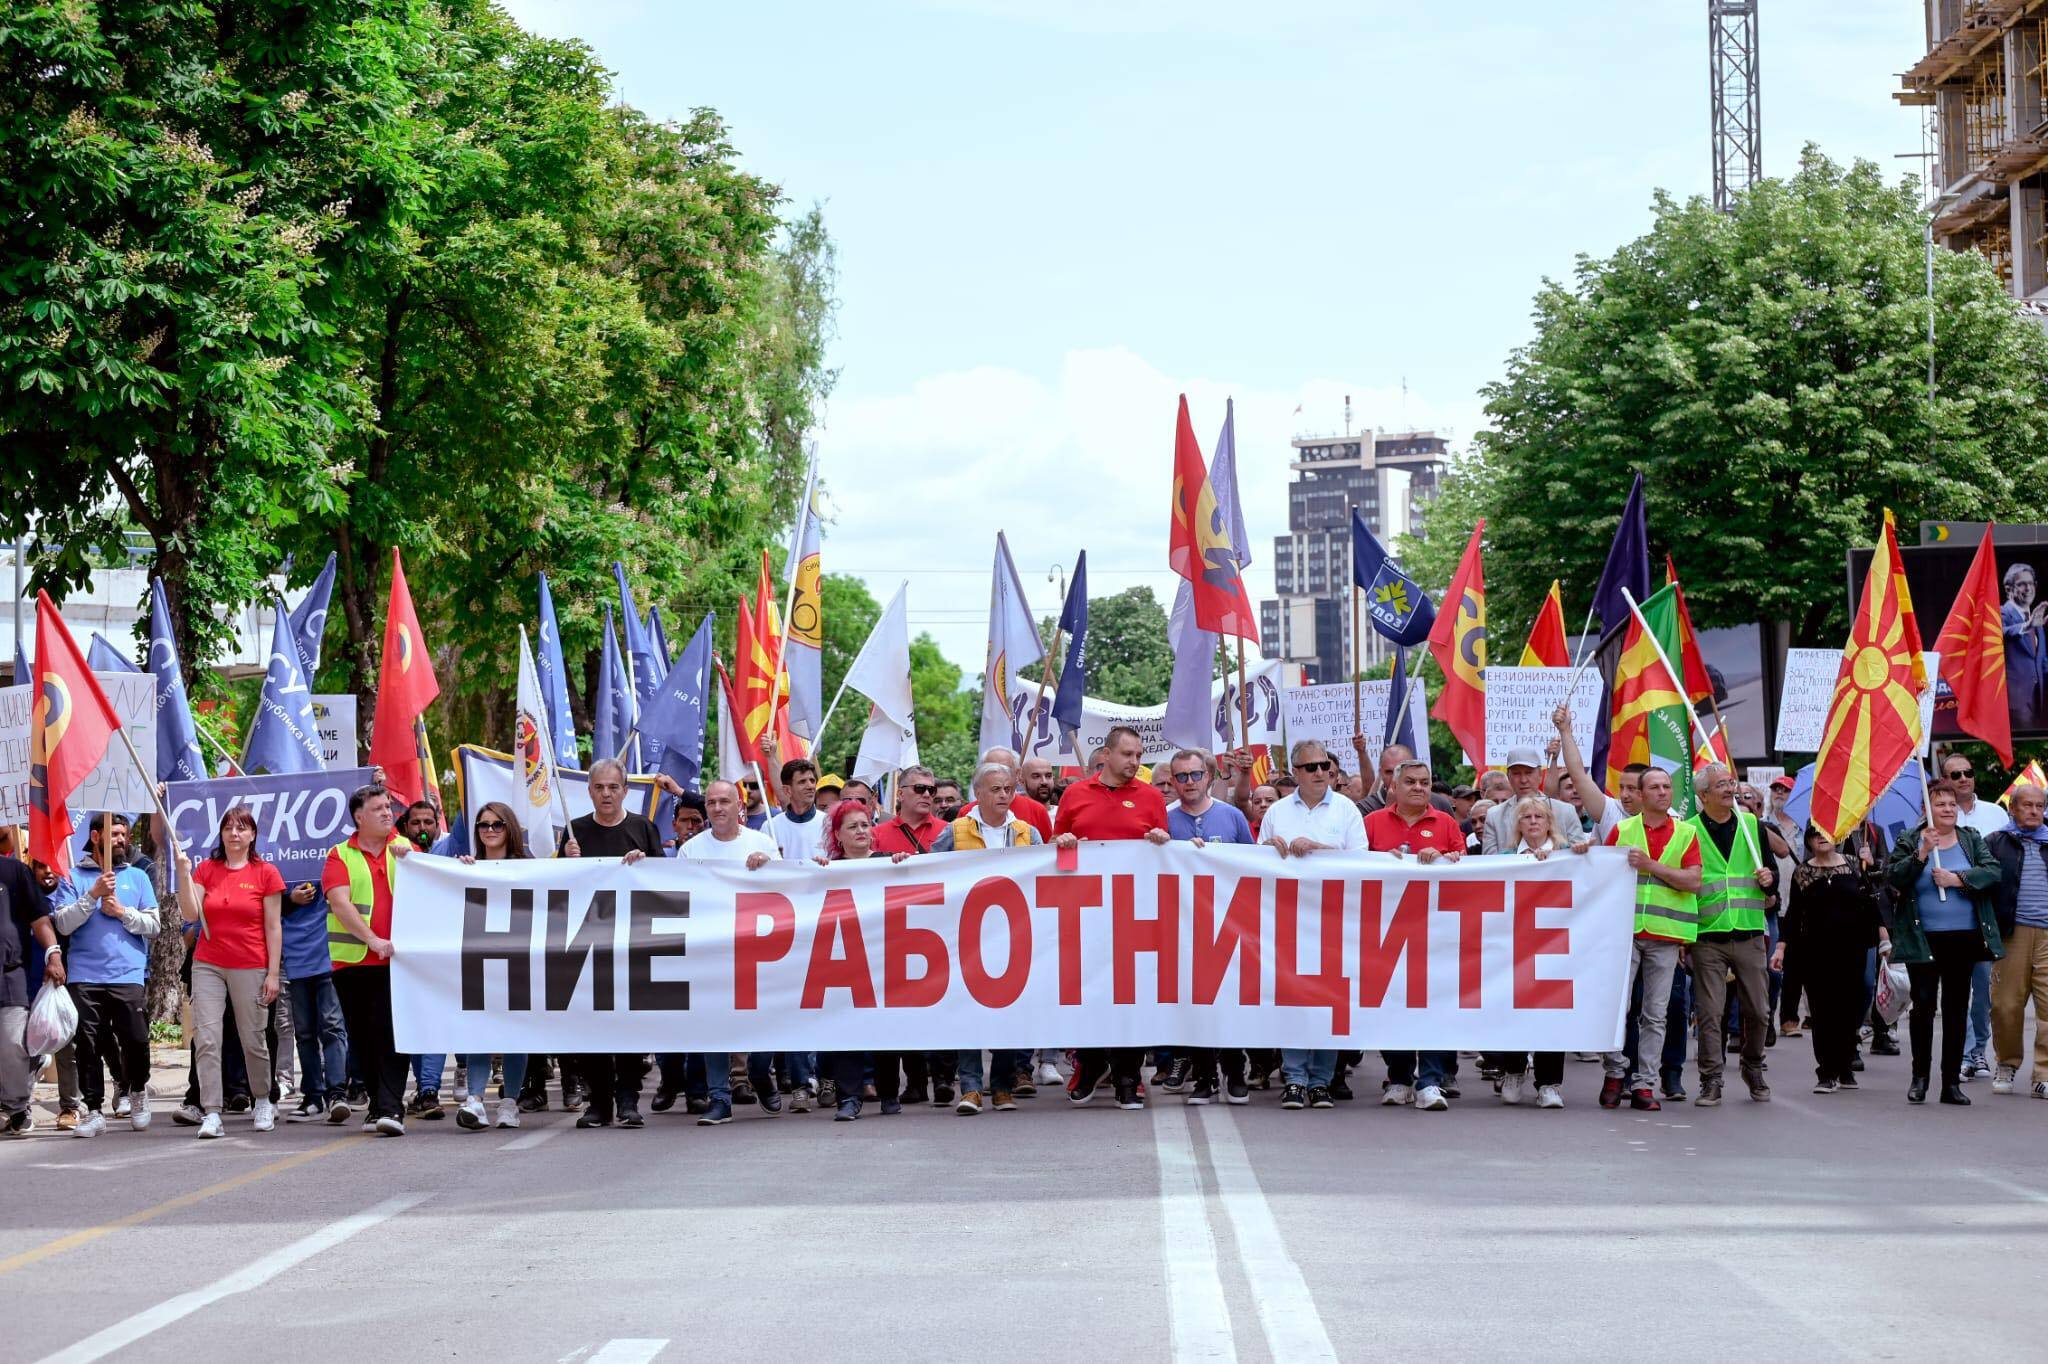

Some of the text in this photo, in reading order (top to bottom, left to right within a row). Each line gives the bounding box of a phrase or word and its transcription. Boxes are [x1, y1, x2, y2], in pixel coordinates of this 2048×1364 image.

[1288, 684, 1391, 701] ТРАНСФОРМРАЊЕ
[1487, 697, 1534, 708] ОЈНИЦИ
[1486, 709, 1528, 720] РУГИТЕ
[461, 873, 1574, 1036] НИЕ РАБОТНИЦИТЕ
